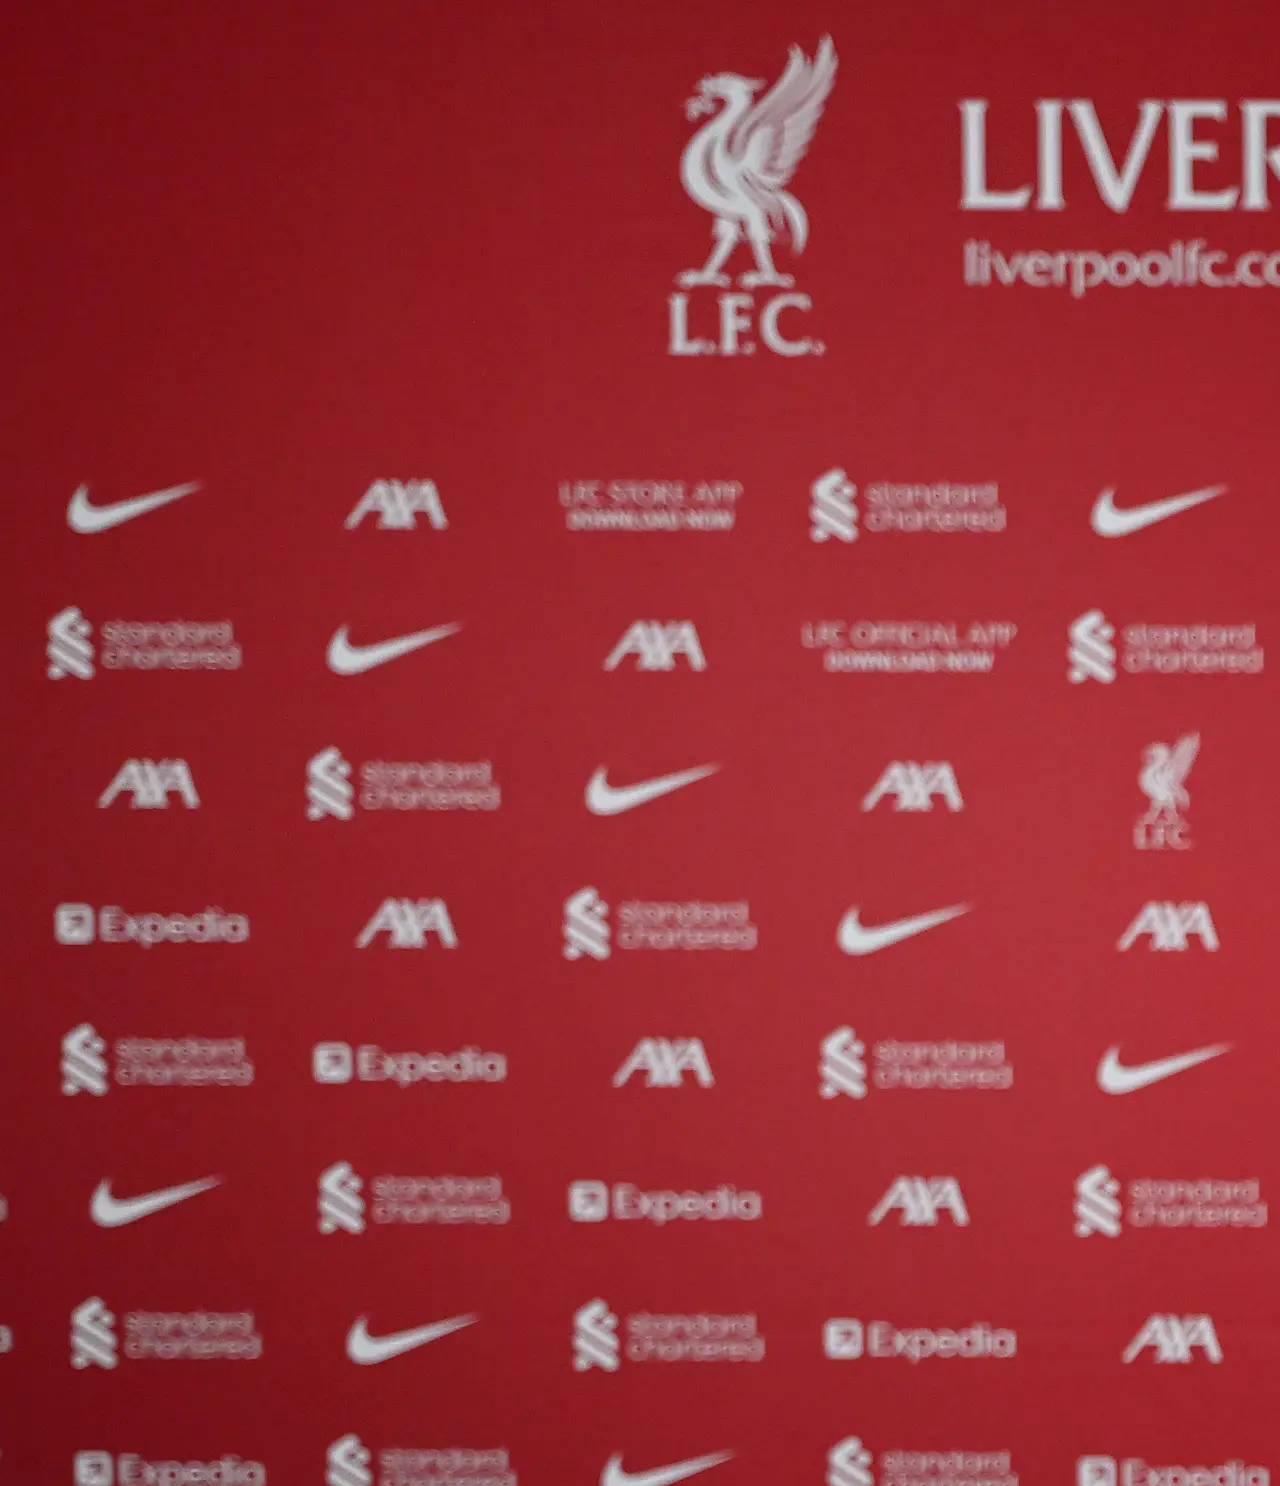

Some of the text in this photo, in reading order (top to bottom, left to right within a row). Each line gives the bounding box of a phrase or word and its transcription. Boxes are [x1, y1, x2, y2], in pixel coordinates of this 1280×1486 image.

[668, 292, 826, 357] L.F.C.
[345, 479, 448, 529] AXA
[603, 620, 707, 671] AXA
[98, 758, 200, 808] AXA
[861, 761, 964, 812] AXA
[100, 907, 250, 945] Expedia
[356, 898, 458, 948] AXA
[1117, 901, 1219, 951] AXA
[358, 1046, 508, 1084] Expedia
[613, 1037, 715, 1087] AXA
[613, 1184, 763, 1222] Expedia
[868, 1176, 969, 1226] AXA
[868, 1322, 1018, 1361] Expedia
[1122, 1314, 1223, 1364] AXA
